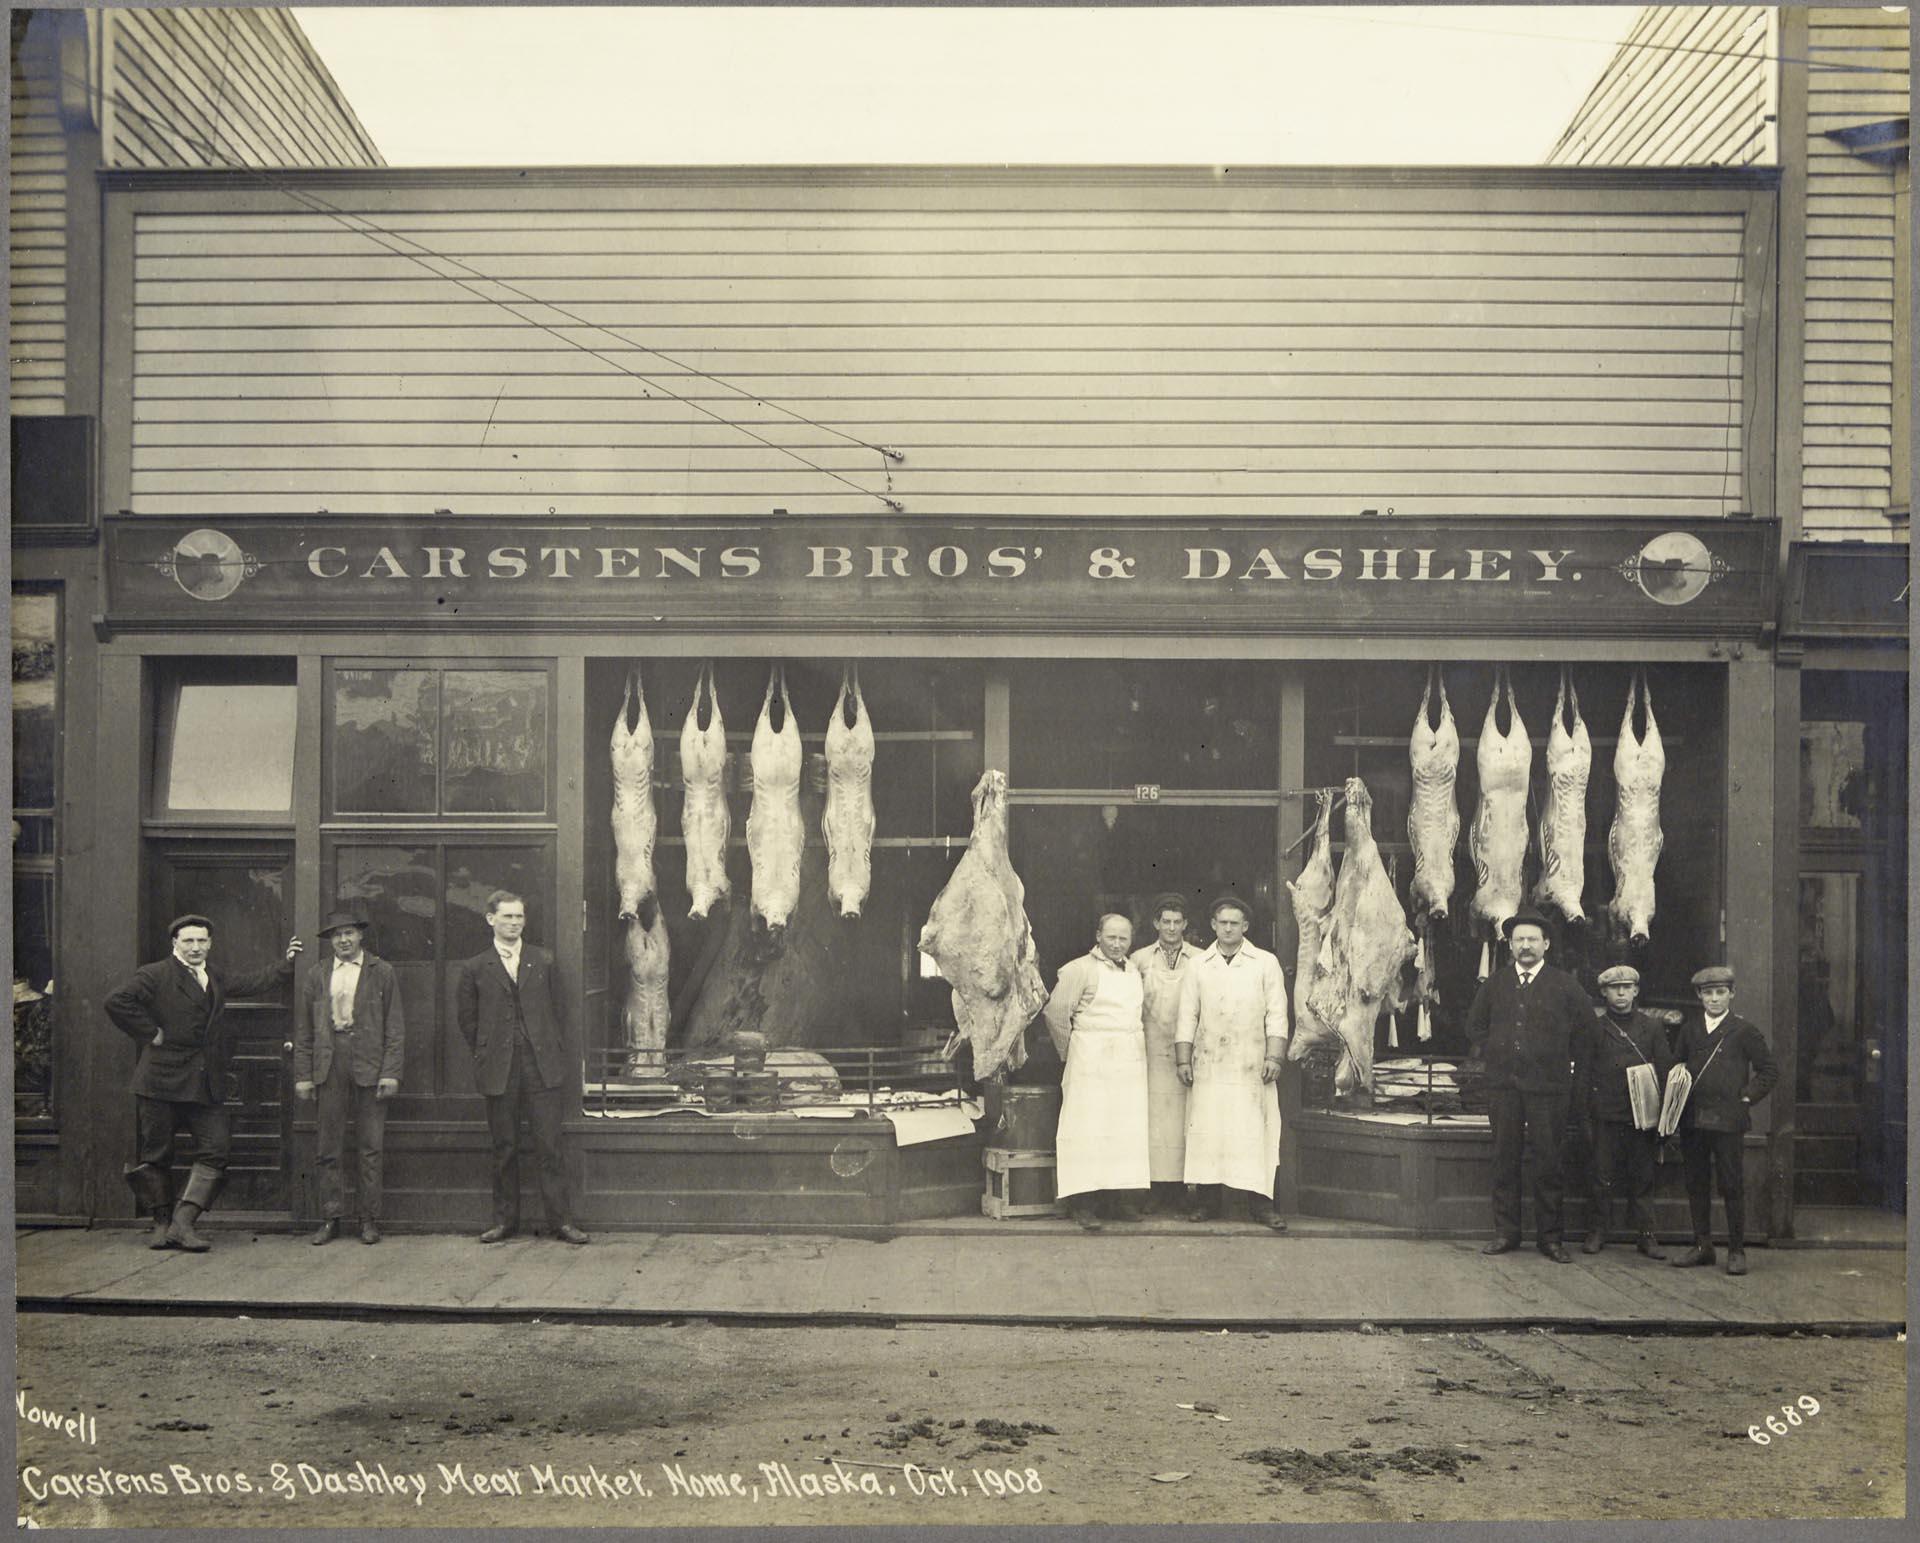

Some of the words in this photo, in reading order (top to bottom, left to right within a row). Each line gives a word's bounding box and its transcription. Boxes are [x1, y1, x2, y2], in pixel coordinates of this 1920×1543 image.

[306, 545, 762, 579] CARSTENS
[805, 545, 1044, 579] BROS'
[1088, 547, 1136, 580] &
[1181, 548, 1583, 582] DASHLEY.
[1136, 786, 1159, 800] 126
